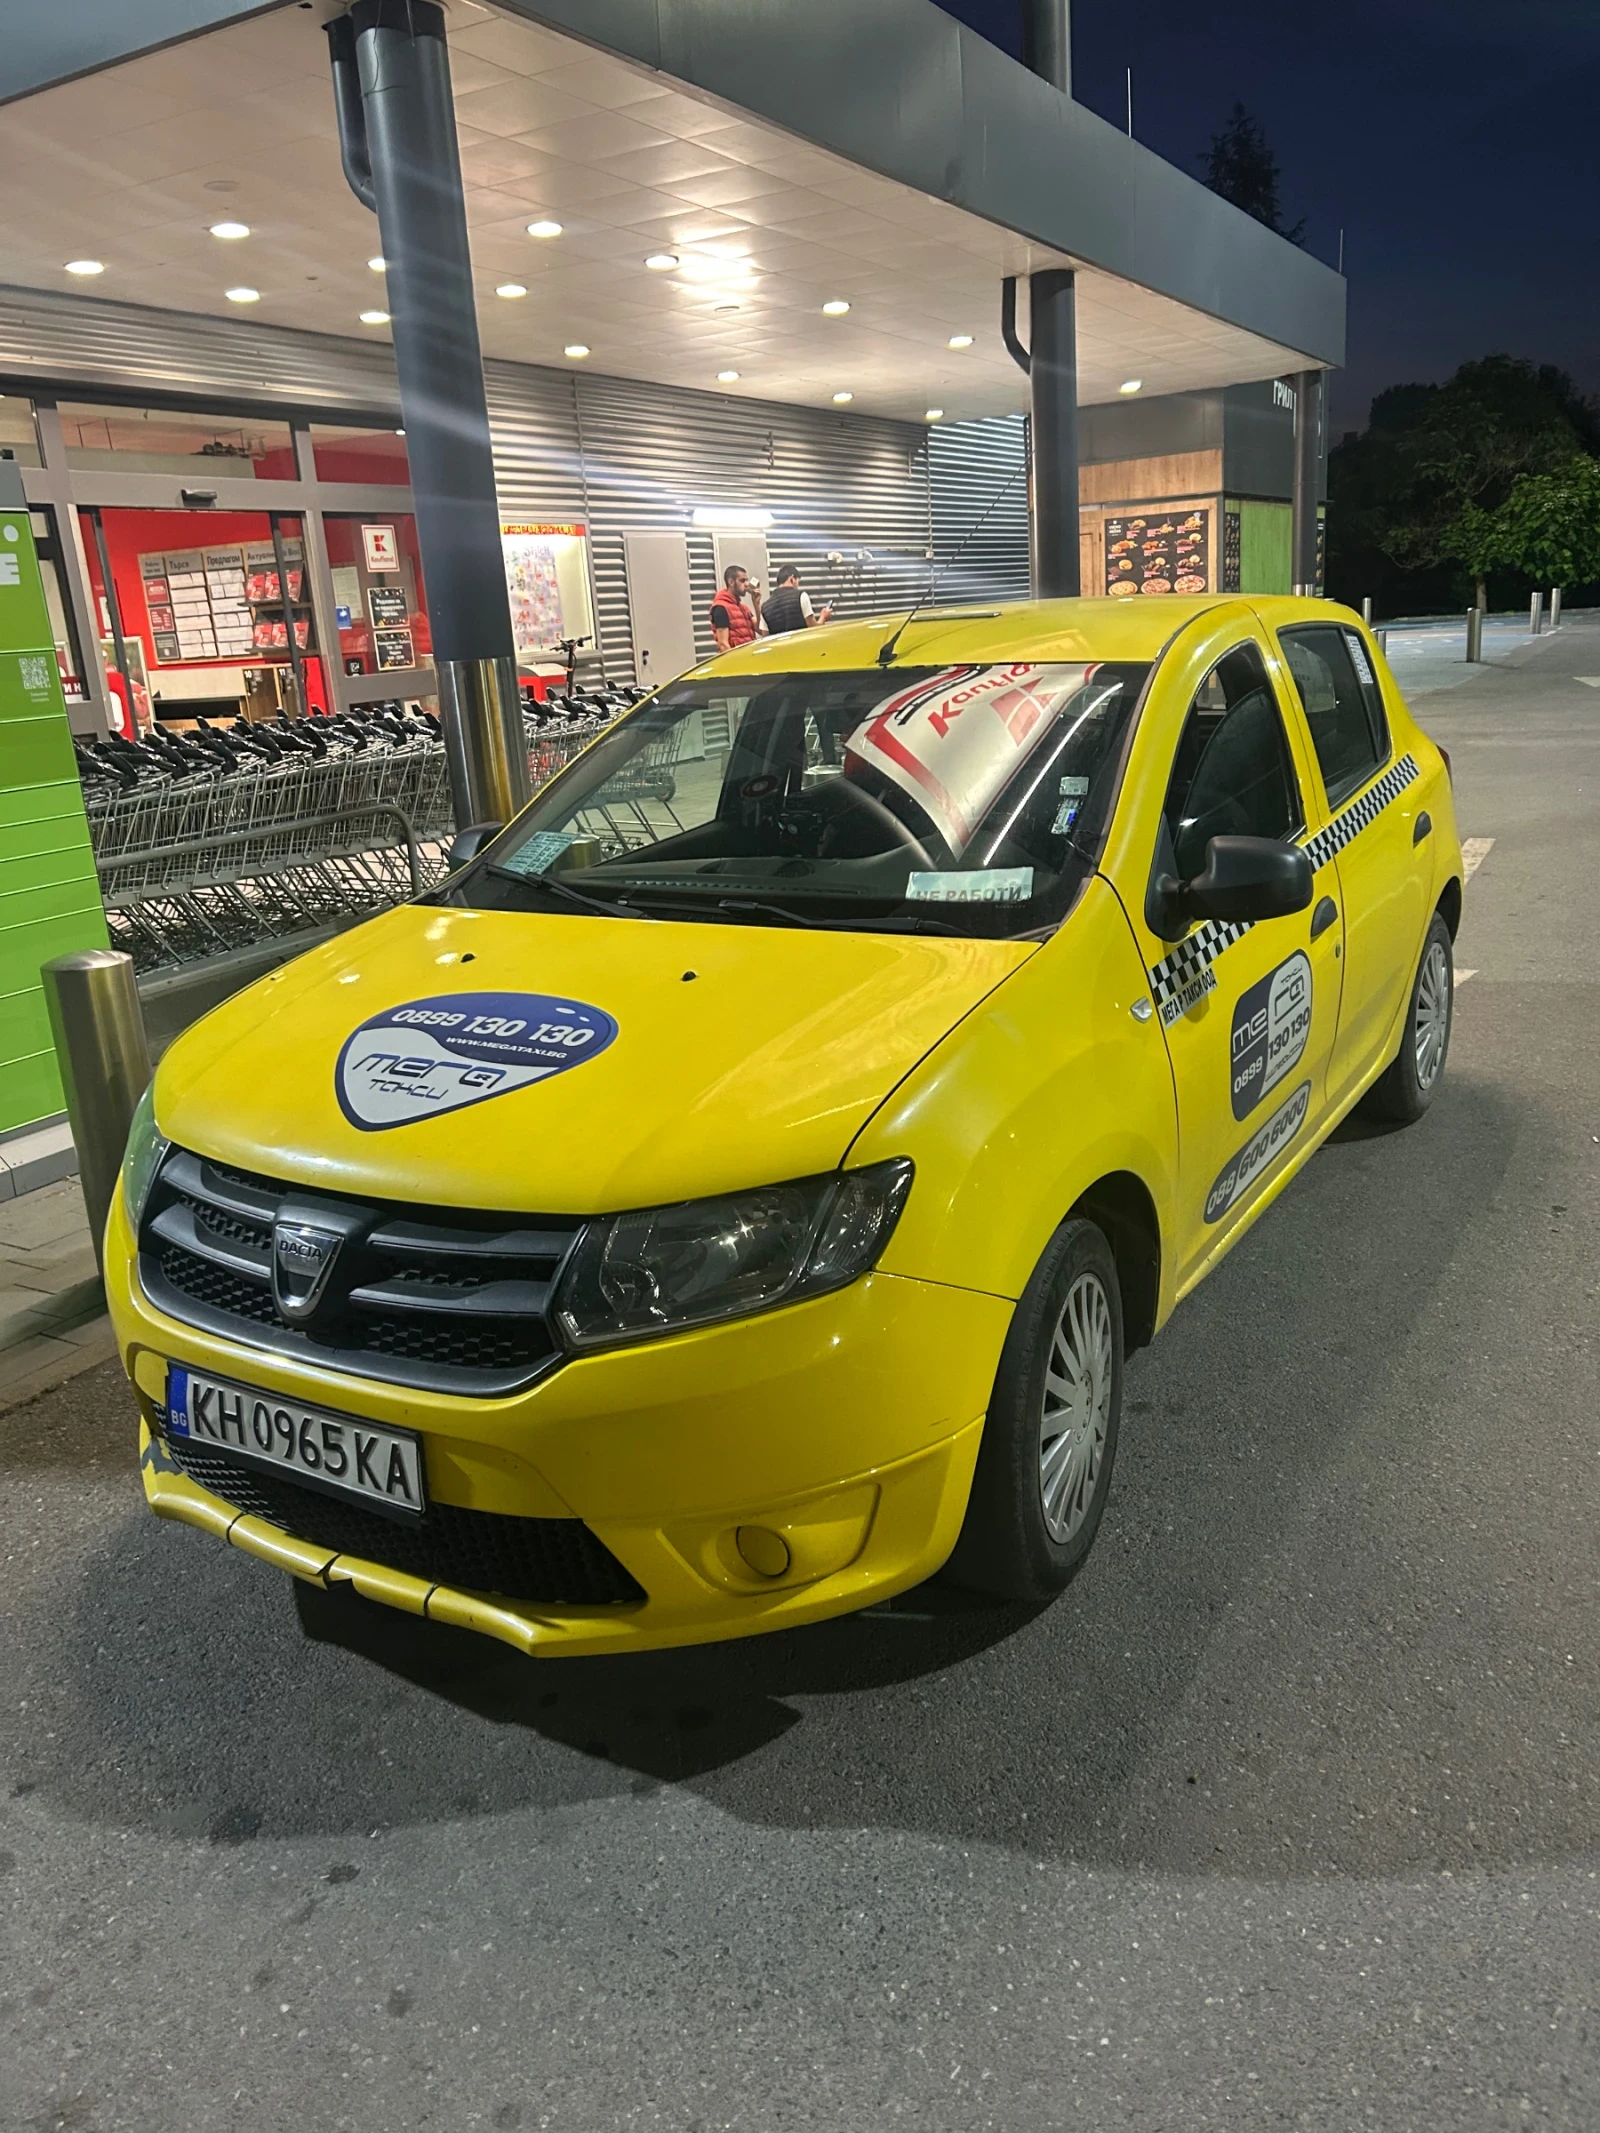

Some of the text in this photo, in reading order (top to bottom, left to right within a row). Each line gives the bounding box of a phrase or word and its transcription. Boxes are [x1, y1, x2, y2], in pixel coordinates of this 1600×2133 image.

[169, 560, 190, 570] Търся
[206, 555, 241, 567] Предлагам
[248, 551, 274, 561] Актуалн
[371, 555, 394, 563] Kaufland
[244, 670, 252, 678] 10
[391, 1009, 595, 1047] 0899 130 130
[446, 1036, 568, 1060] WWW.MEGATAXI.BG
[1234, 1056, 1263, 1093] 0899
[1268, 1026, 1290, 1060] 130
[1291, 1006, 1310, 1039] 130
[1207, 1170, 1237, 1215] 088
[279, 1240, 323, 1259] DACIA
[170, 1410, 188, 1428] BG
